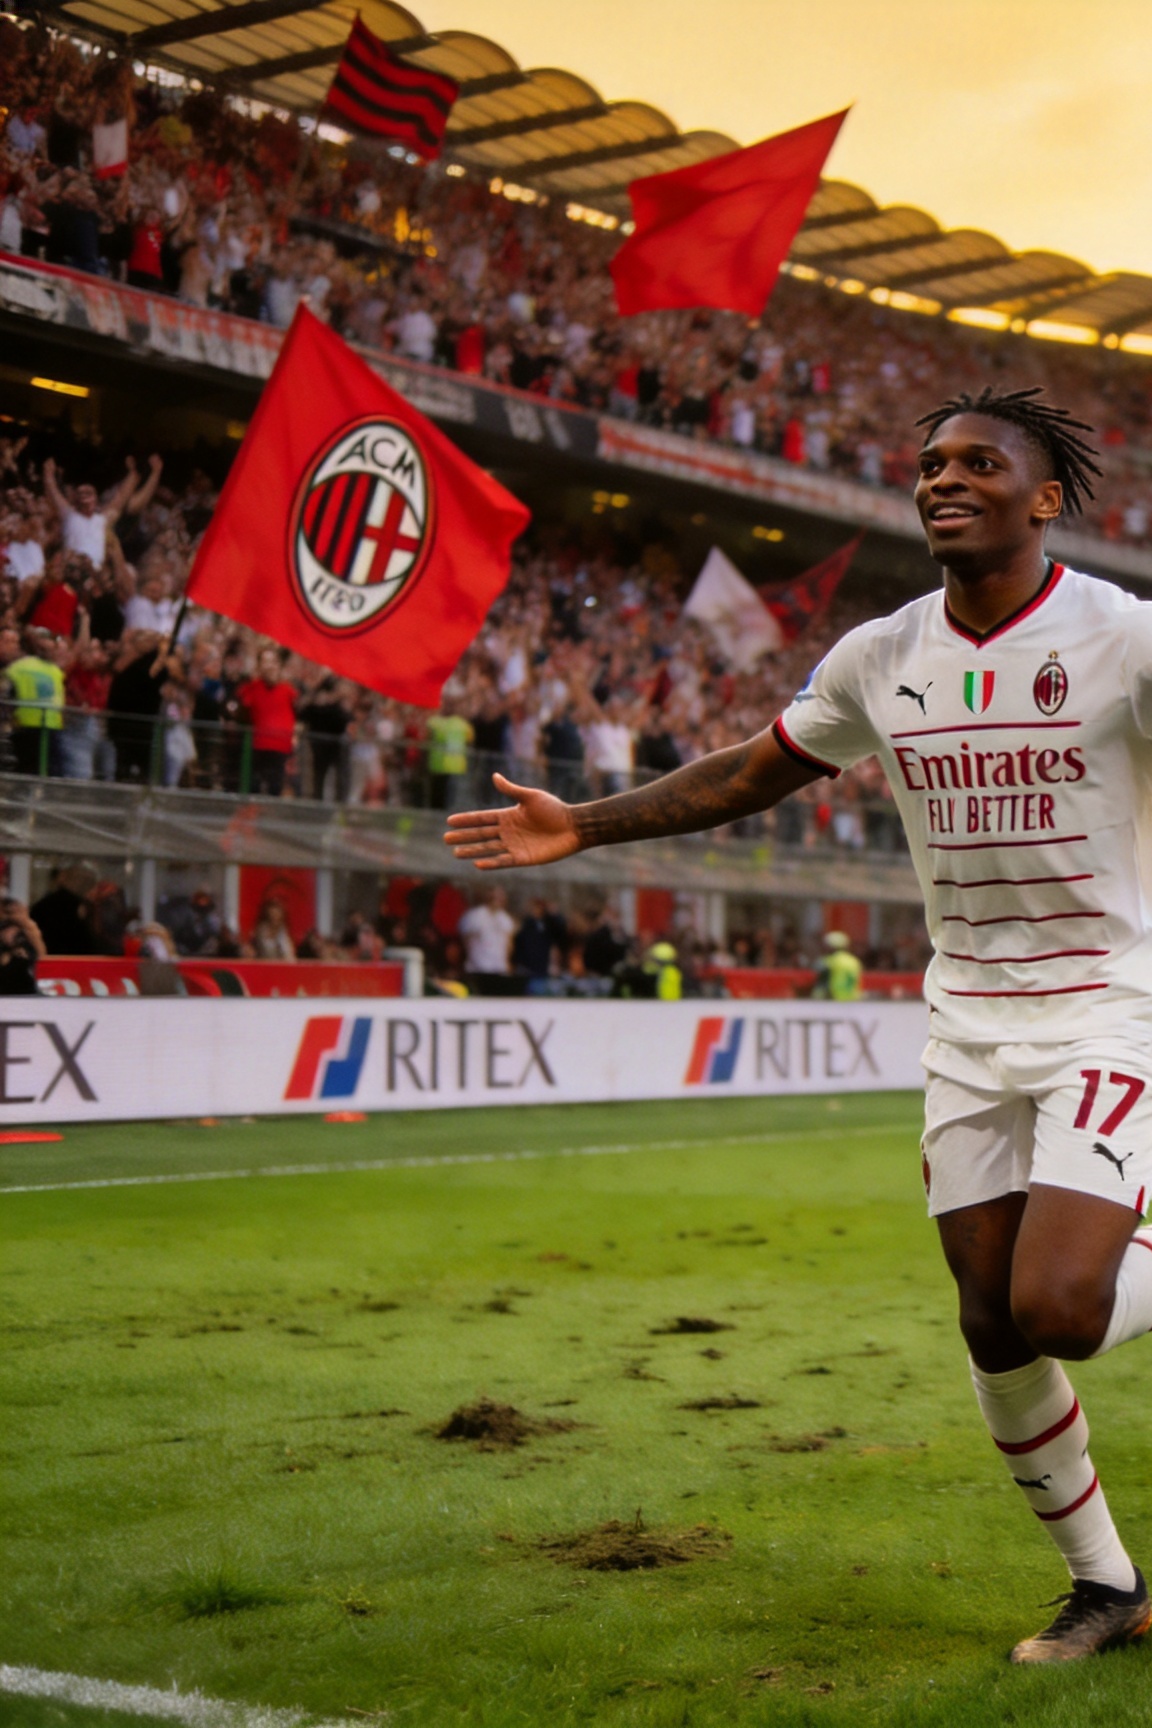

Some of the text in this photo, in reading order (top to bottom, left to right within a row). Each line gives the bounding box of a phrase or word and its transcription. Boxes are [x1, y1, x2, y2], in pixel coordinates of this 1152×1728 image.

[337, 434, 415, 488] ACM
[893, 741, 1086, 790] Emirates
[967, 793, 1055, 834] BETTER
[0, 1020, 98, 1105] EX
[386, 1018, 556, 1092] RITEX
[756, 1018, 881, 1081] RITEX
[1073, 1069, 1146, 1137] 17
